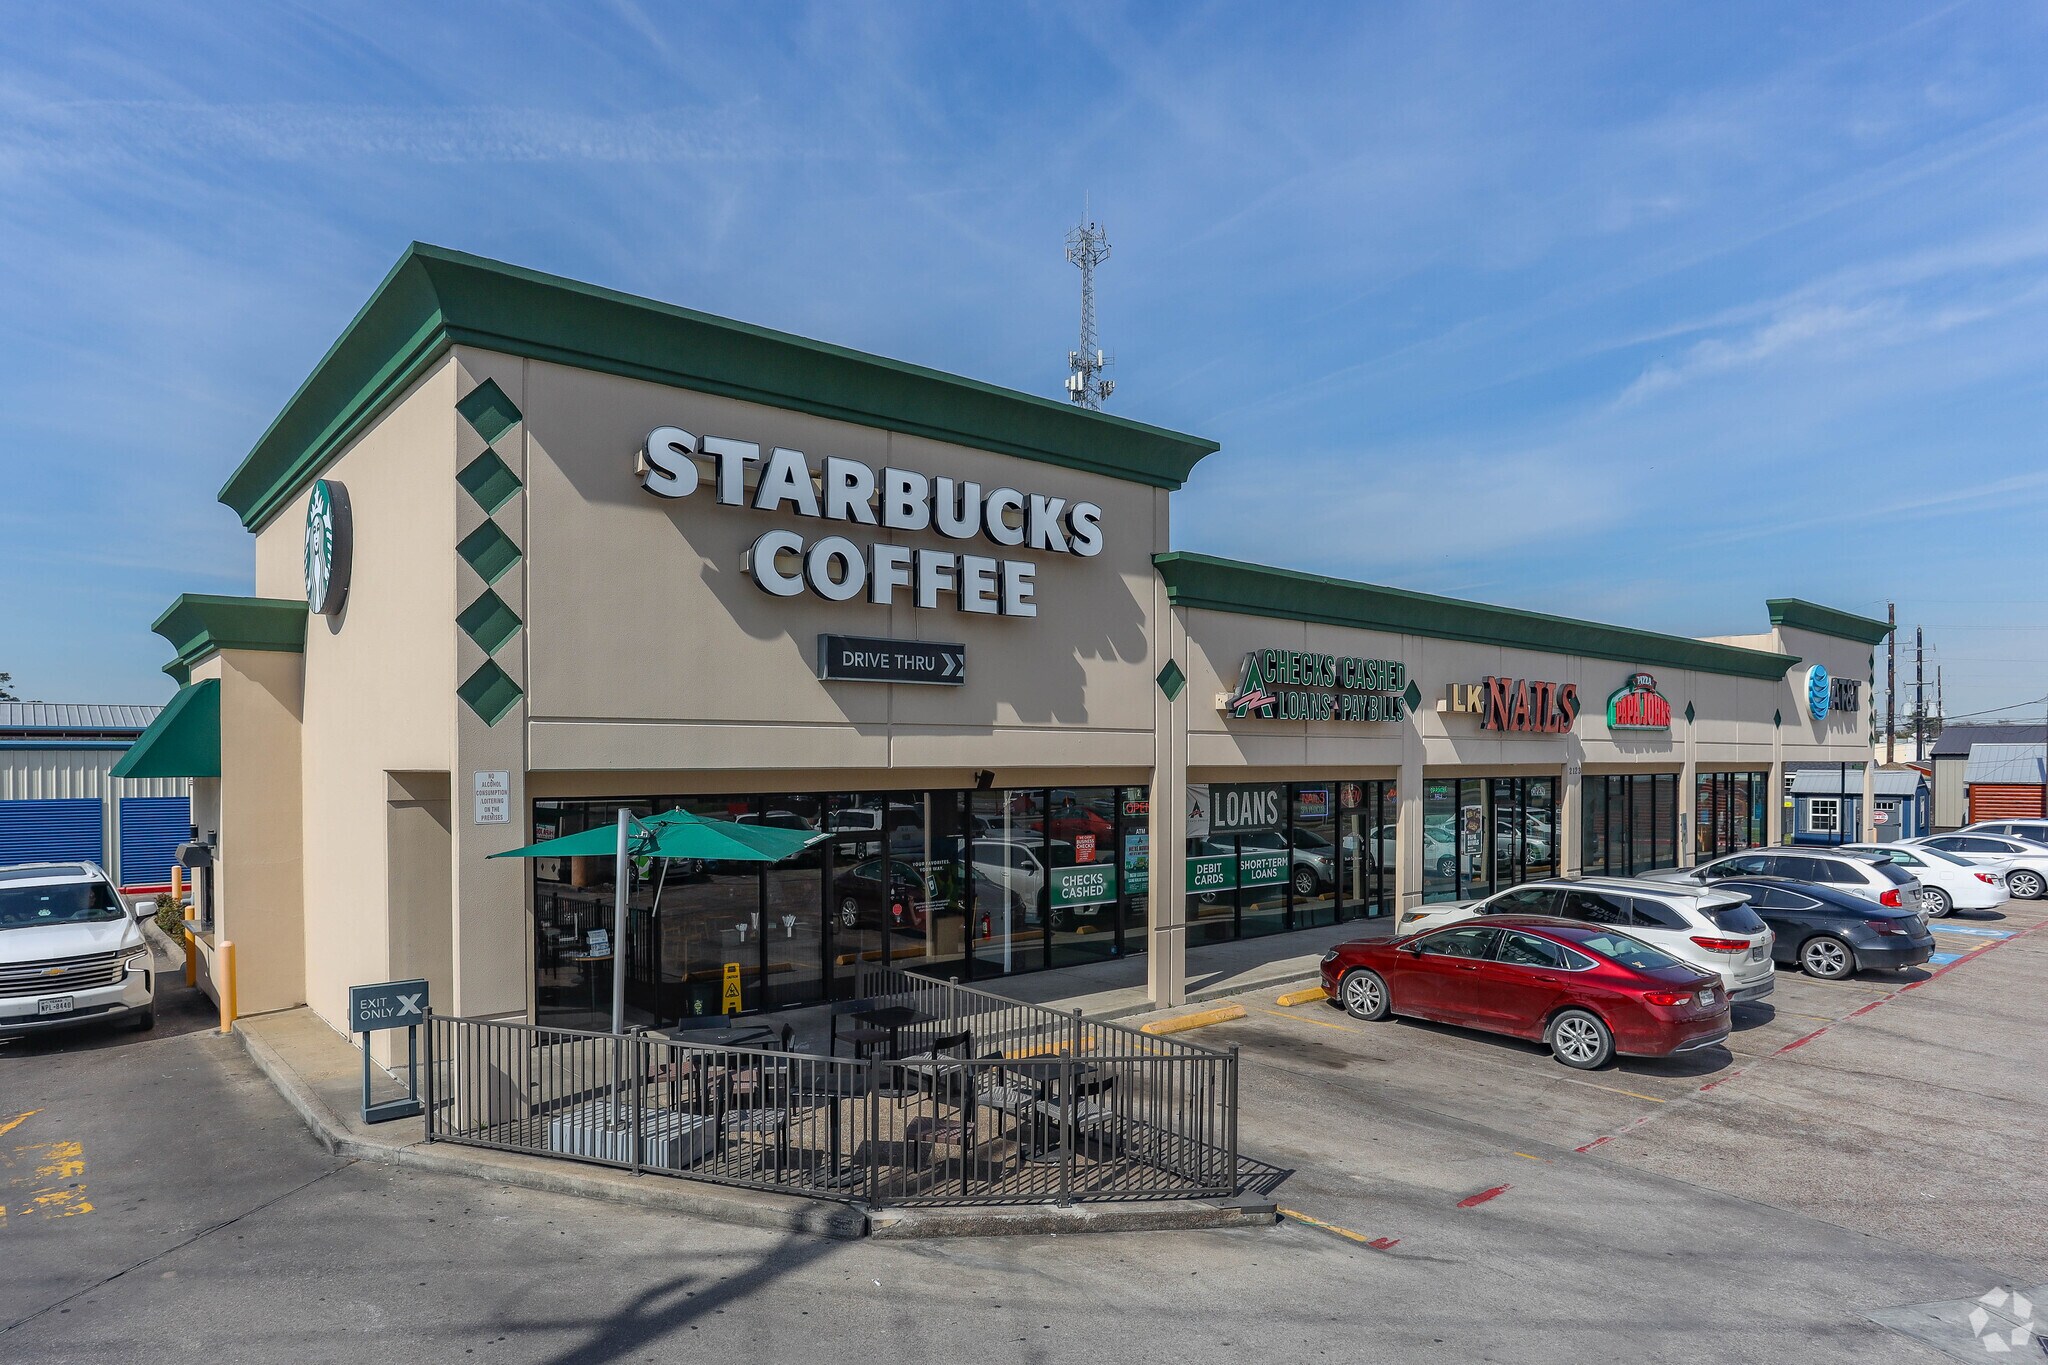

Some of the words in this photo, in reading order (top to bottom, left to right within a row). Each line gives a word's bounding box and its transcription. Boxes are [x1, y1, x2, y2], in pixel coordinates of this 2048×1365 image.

[641, 425, 1104, 558] STARBUCKS
[749, 529, 1037, 617] COFFEE
[842, 651, 890, 669] DRIVE
[894, 654, 935, 671] THRU
[1261, 648, 1336, 688] CHECKS
[1341, 656, 1406, 692] CASHED
[1637, 675, 1652, 686] PIZZA
[1830, 678, 1861, 711] AT&T
[1278, 691, 1331, 721] LOANS
[1448, 683, 1483, 713] LK
[1484, 676, 1576, 734] NAILS
[1616, 692, 1641, 725] PAPA
[1214, 790, 1279, 827] LOANS
[1196, 863, 1222, 875] DEBIT
[1240, 857, 1289, 871] SHORT-TERM
[1062, 873, 1103, 887] CHECKS
[1194, 873, 1224, 886] CARDS
[1251, 868, 1278, 880] LOANS
[1061, 885, 1104, 899] CASHED
[360, 997, 388, 1010] EXIT
[360, 1007, 394, 1020] ONLY
